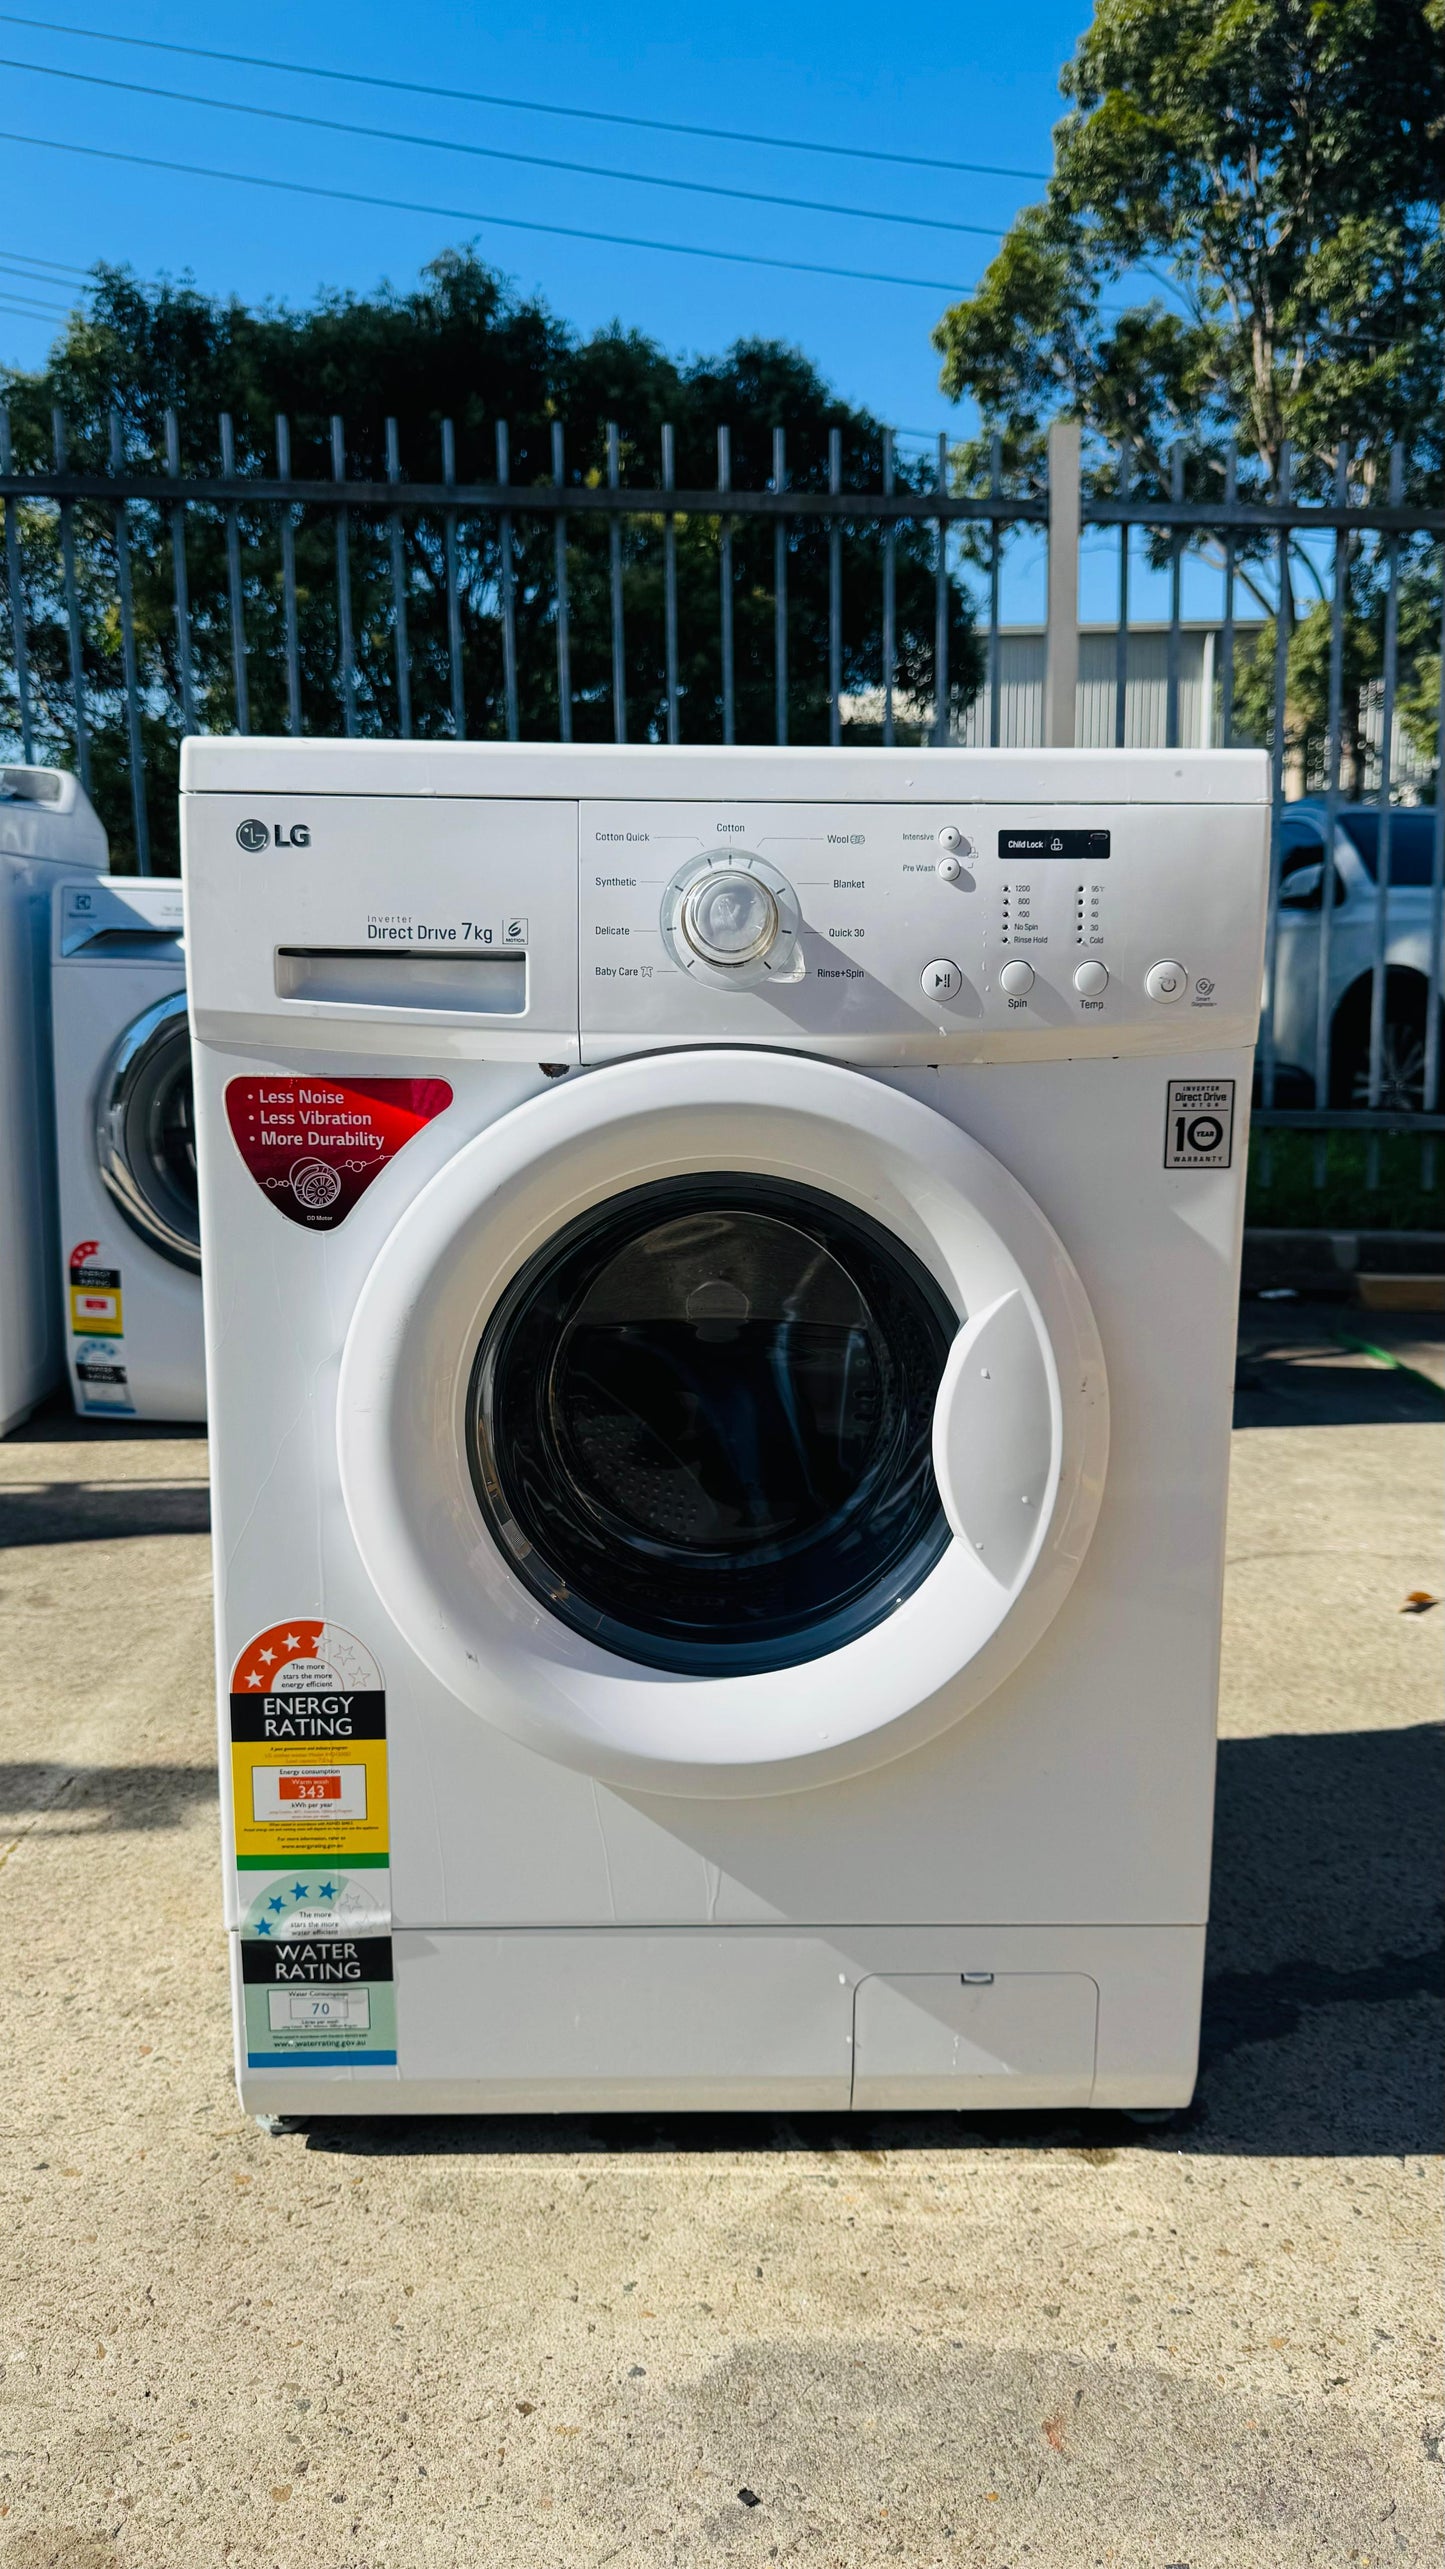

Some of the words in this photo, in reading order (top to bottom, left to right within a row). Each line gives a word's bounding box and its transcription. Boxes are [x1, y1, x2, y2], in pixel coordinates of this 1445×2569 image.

[716, 823, 745, 833] Cotton
[274, 824, 311, 848] LG
[595, 832, 624, 841] Cotton
[626, 832, 650, 842] Quick
[827, 835, 849, 844] Wool
[902, 833, 934, 841] Intensive
[1008, 840, 1026, 849] Child
[1027, 840, 1043, 849] Lock
[902, 864, 914, 872] Pre
[916, 864, 936, 872] Wash
[595, 877, 637, 887] Synthetic
[833, 880, 865, 889] Blanket
[367, 915, 412, 923] Inverter
[367, 925, 413, 940] Direct
[418, 925, 456, 940] Drive
[595, 926, 630, 935] Delicate
[829, 928, 852, 938] Quick
[854, 928, 865, 937] 30
[1024, 924, 1038, 932] Spin
[1033, 936, 1048, 944] Hold
[595, 967, 616, 977] Baby
[619, 967, 638, 976] Care
[817, 968, 864, 979] Rinse+Spin
[1008, 999, 1028, 1010] Spin
[1080, 1000, 1104, 1011] Temp
[259, 1089, 294, 1103] Less
[299, 1089, 344, 1104] Noise
[1175, 1093, 1202, 1102] Direct
[1204, 1093, 1227, 1101] Drive
[260, 1111, 295, 1125] Less
[298, 1111, 371, 1125] Vibration
[1175, 1116, 1223, 1151] 10
[261, 1132, 303, 1145] More
[307, 1132, 385, 1149] Durability
[281, 1681, 304, 1689] energy
[306, 1680, 333, 1688] efficient
[263, 1697, 354, 1716] ENERGY
[265, 1718, 353, 1737] RATING
[299, 1786, 325, 1798] 343
[276, 1943, 358, 1961] WATER
[276, 1963, 361, 1980] RATING
[311, 2003, 330, 2015] 70
